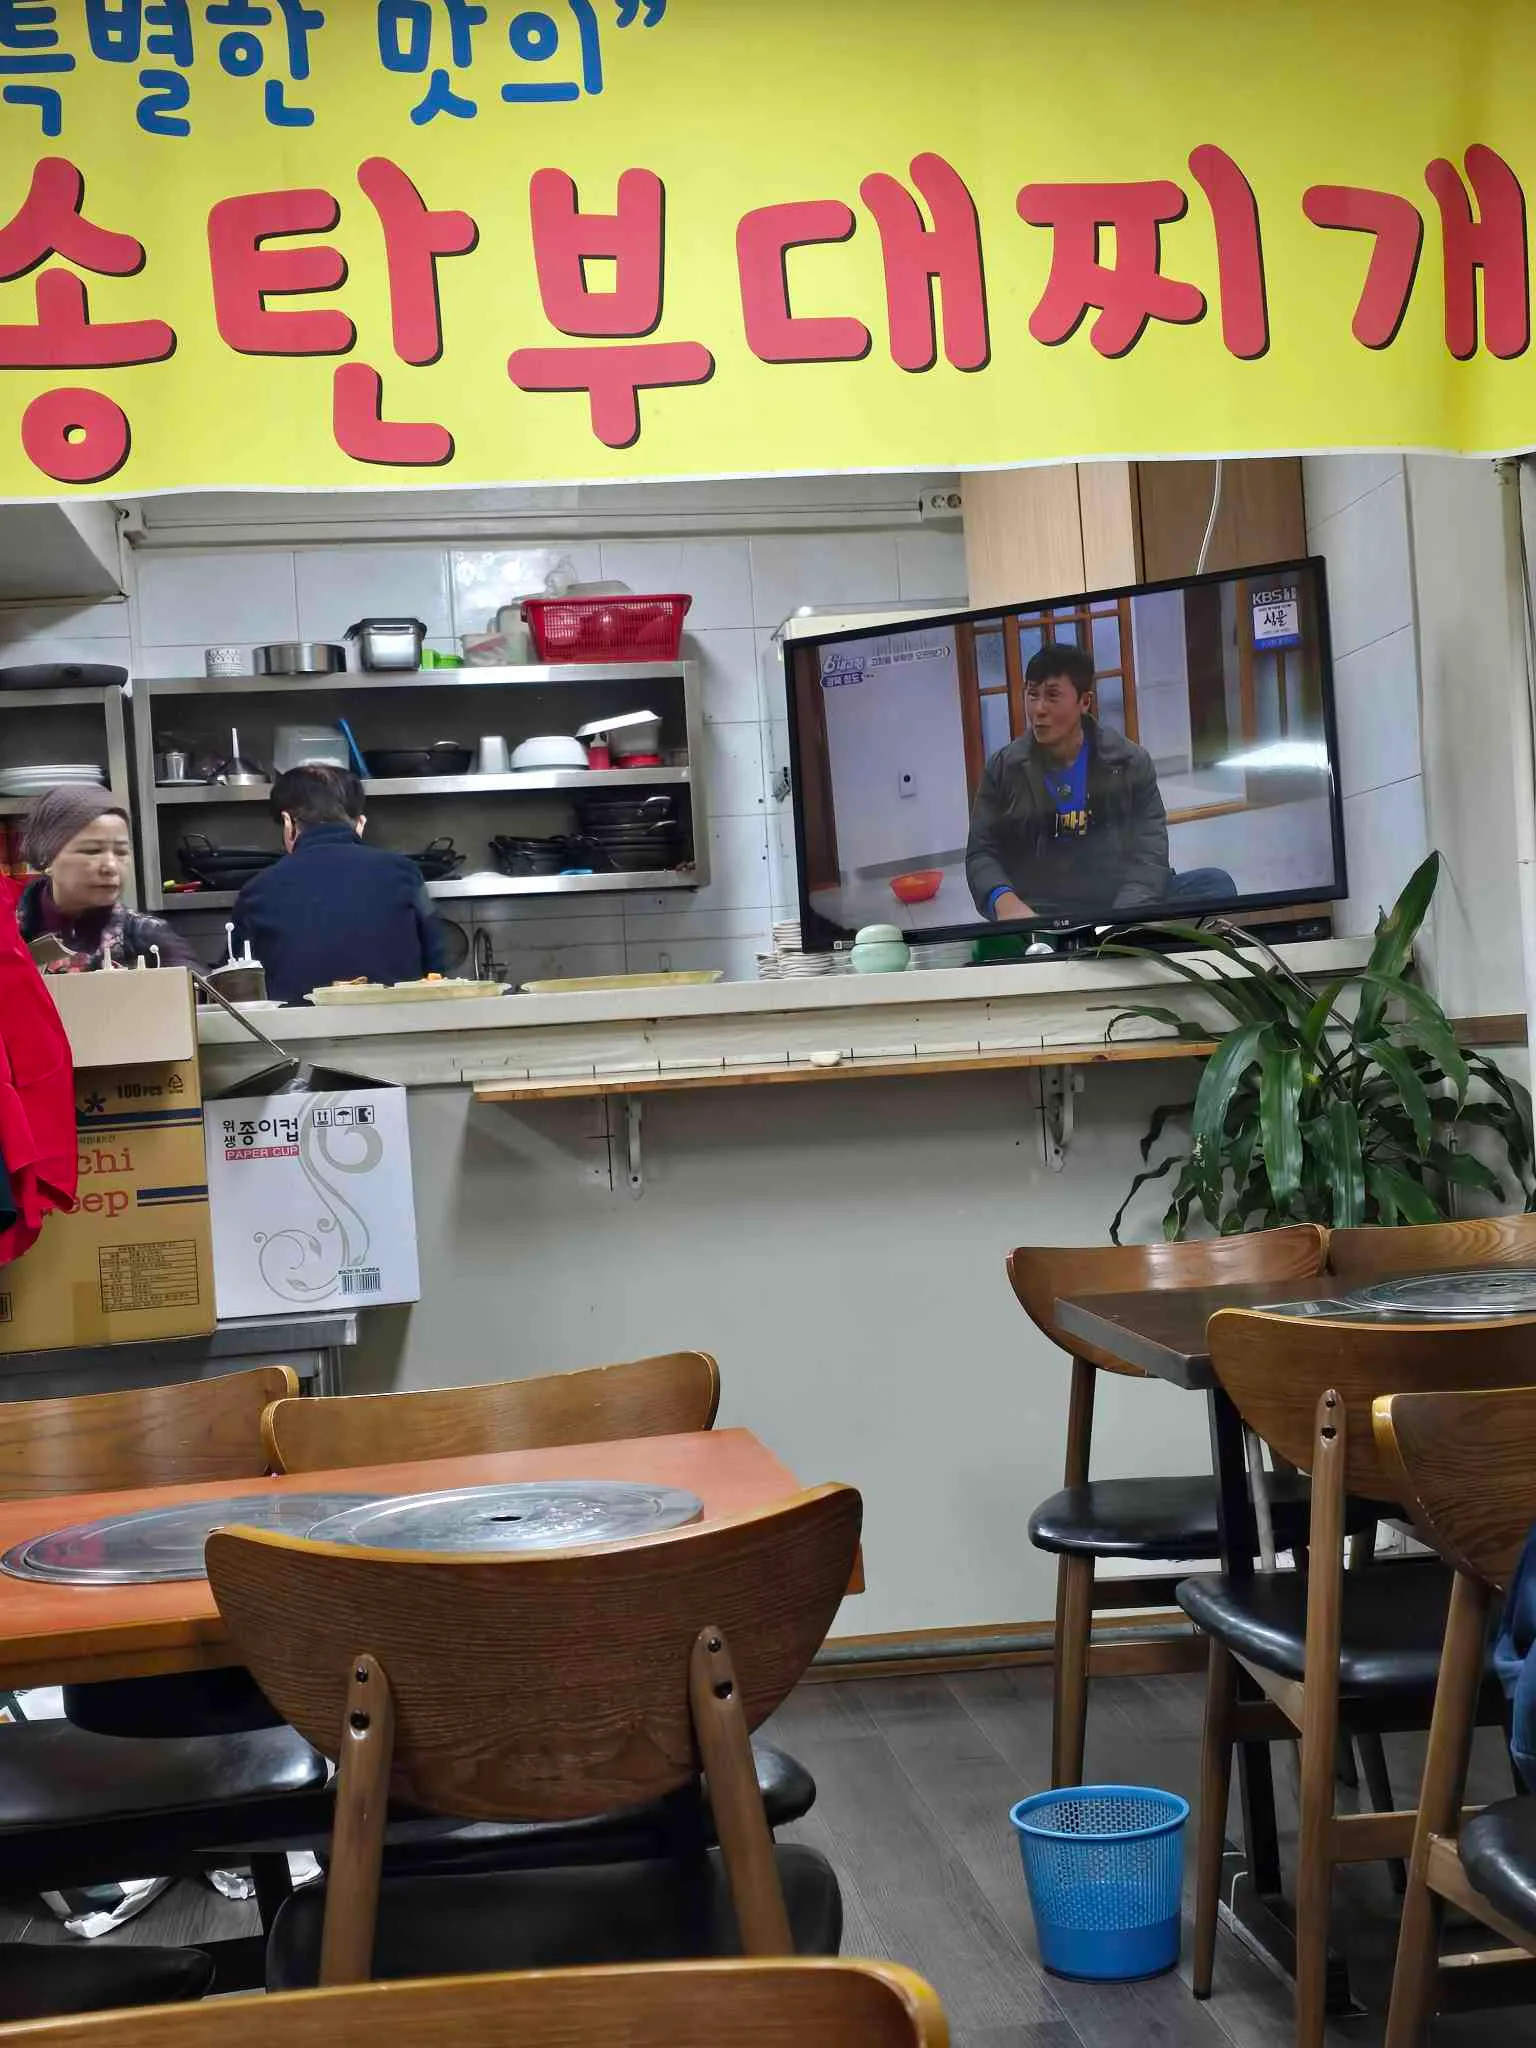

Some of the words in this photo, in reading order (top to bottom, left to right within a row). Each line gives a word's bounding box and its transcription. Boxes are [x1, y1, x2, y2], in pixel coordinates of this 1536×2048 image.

[0, 0, 324, 137] 특별한
[238, 1117, 299, 1146] 종이컵
[226, 1149, 269, 1160] PAPER
[272, 1145, 299, 1157] CUP
